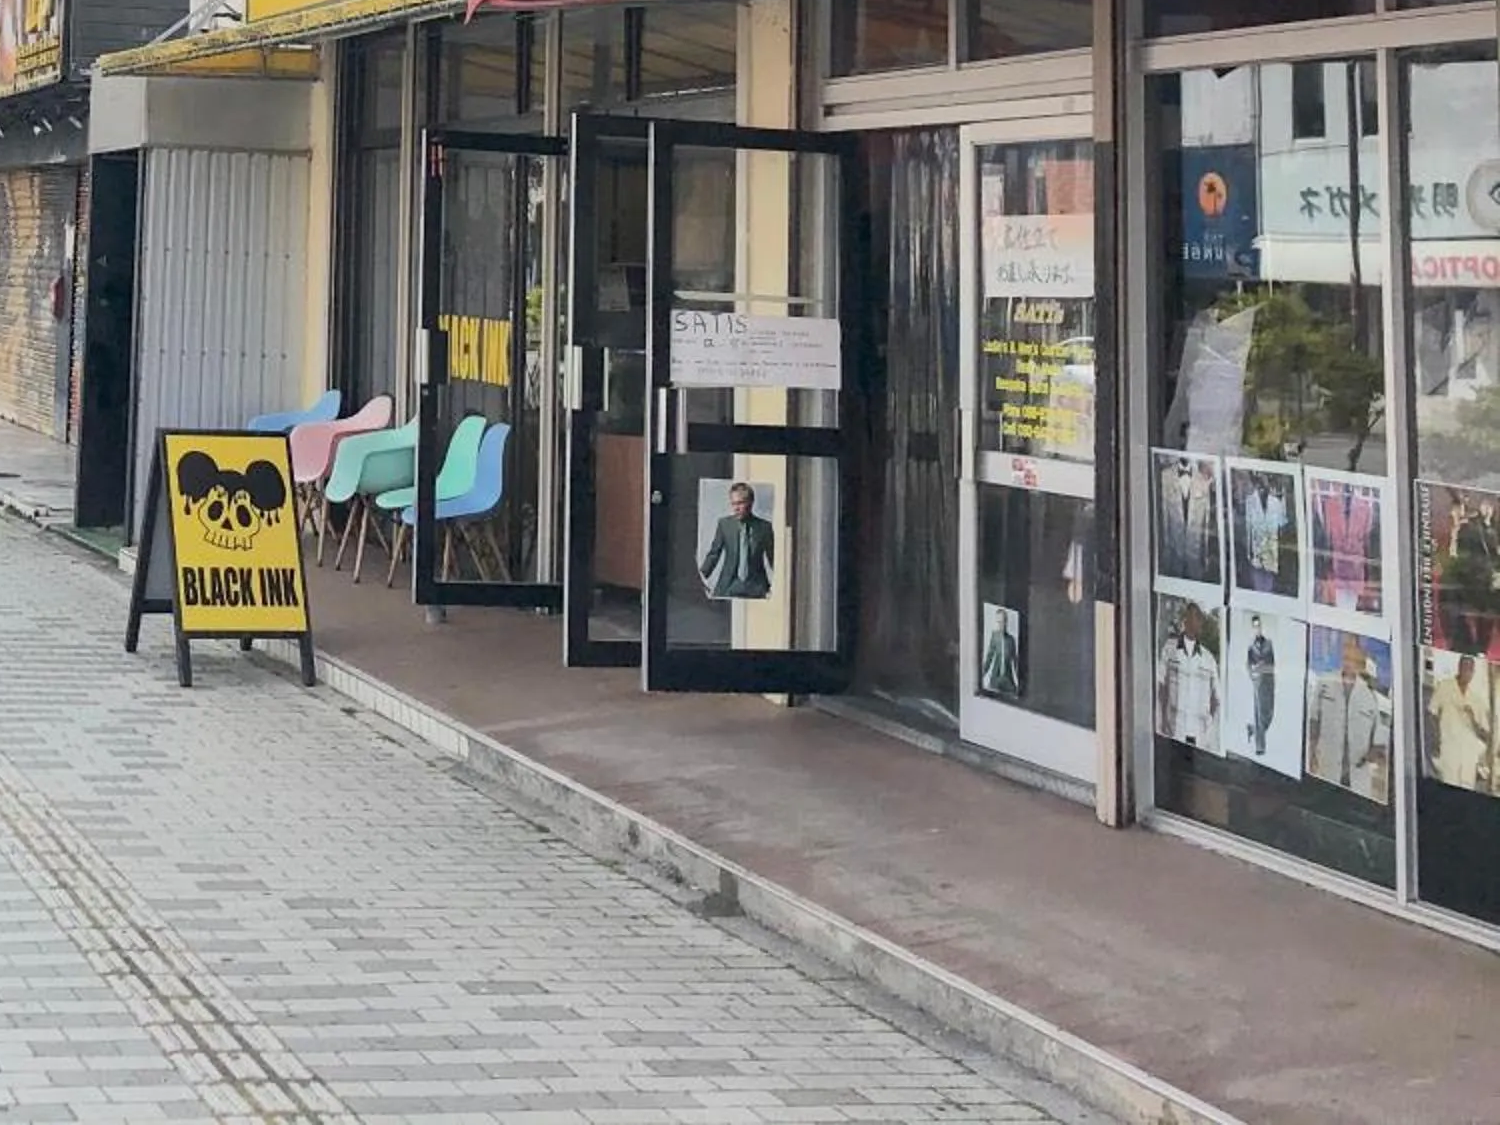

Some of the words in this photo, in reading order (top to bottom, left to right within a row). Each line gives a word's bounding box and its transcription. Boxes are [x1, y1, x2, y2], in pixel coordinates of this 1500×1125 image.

[674, 311, 748, 334] SATIS
[182, 566, 256, 606] BLACK
[258, 567, 299, 607] INK
